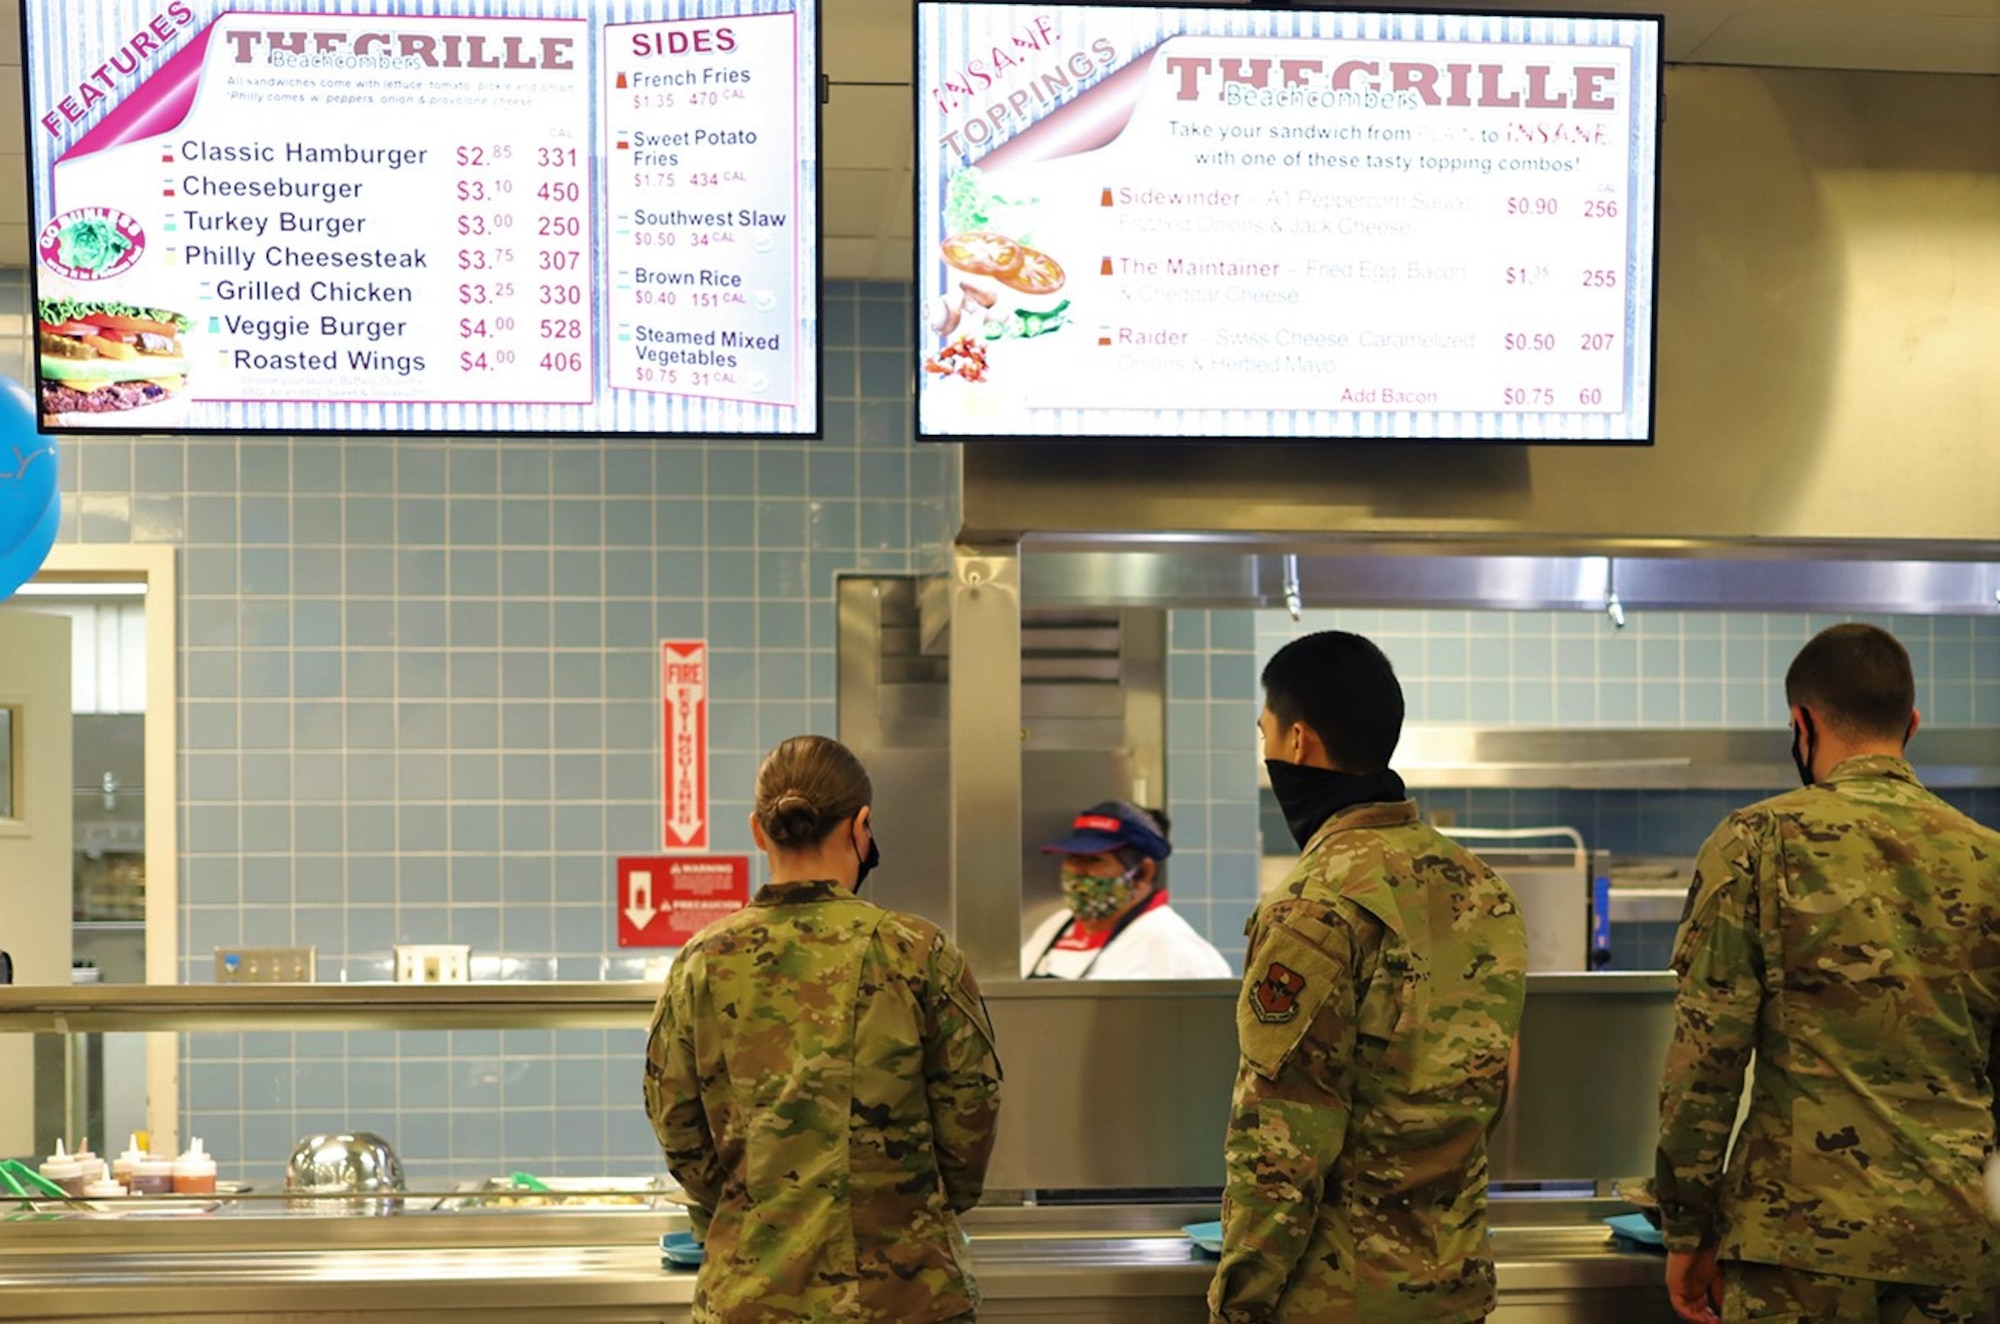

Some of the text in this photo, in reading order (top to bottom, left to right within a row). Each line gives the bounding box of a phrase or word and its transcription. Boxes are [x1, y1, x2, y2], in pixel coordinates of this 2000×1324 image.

[226, 30, 574, 69] THE GRILLE
[631, 28, 736, 56] SIDES
[41, 1, 192, 137] FEATURES
[272, 49, 423, 70] Beachcombers
[227, 76, 244, 87] All
[246, 76, 317, 88] sandwiches
[320, 79, 351, 88] come
[356, 78, 381, 89] with
[632, 68, 751, 88] French Fries
[1167, 57, 1616, 110] THE GRILLE
[267, 93, 305, 103] comes
[381, 95, 414, 105] onion
[633, 89, 746, 110] $1.35 470 CAL
[939, 38, 1115, 156] TOPPINGS
[1226, 82, 1419, 110] Beachcombers
[633, 129, 757, 148] Sweet Potato
[1169, 121, 1213, 139] Take
[1219, 125, 1262, 141] your
[1269, 124, 1362, 141] sandwich
[1367, 125, 1411, 142] from
[1481, 129, 1500, 144] to
[182, 140, 428, 169] Classic Hamburger
[537, 147, 577, 167] 331
[634, 151, 678, 168] Fries
[1195, 151, 1582, 174] with one of these tasty topping combos!
[183, 175, 363, 203] Cheeseburger
[634, 171, 746, 188] $1.75 434 CAL
[537, 182, 579, 201] 450
[1119, 187, 1241, 206] Sidewinder
[1506, 196, 1618, 218] $0.90 256
[184, 210, 366, 238] Turkey Burger
[538, 216, 580, 236] 250
[634, 209, 786, 227] Southwest Slaw
[1288, 217, 1332, 234] Jack
[634, 231, 736, 247] $0.50 34 CAL
[185, 245, 428, 271] Philly Cheesesteak
[539, 251, 580, 270] 307
[635, 268, 742, 287] Brown Rice
[1119, 257, 1158, 276] The
[1166, 257, 1281, 277] Maintainer
[1406, 260, 1468, 282] Bacon
[1582, 270, 1617, 289] 255
[217, 280, 412, 302] Grilled Chicken
[539, 285, 581, 304] 330
[635, 289, 746, 307] $0.40 151 CAL
[225, 315, 407, 341] Veggie Burger
[540, 319, 581, 338] 528
[636, 325, 780, 351] Steamed Mixed
[1118, 327, 1189, 346] Raider
[1503, 332, 1615, 352] $0.50 207
[234, 349, 426, 376] Roasted Wings
[540, 352, 582, 371] 406
[636, 346, 737, 368] Vegetables
[636, 366, 737, 385] $0.75 31 CAL
[1340, 387, 1437, 404] Add Bacon
[1503, 387, 1602, 406] $0.75 60
[668, 662, 703, 685] FIRE
